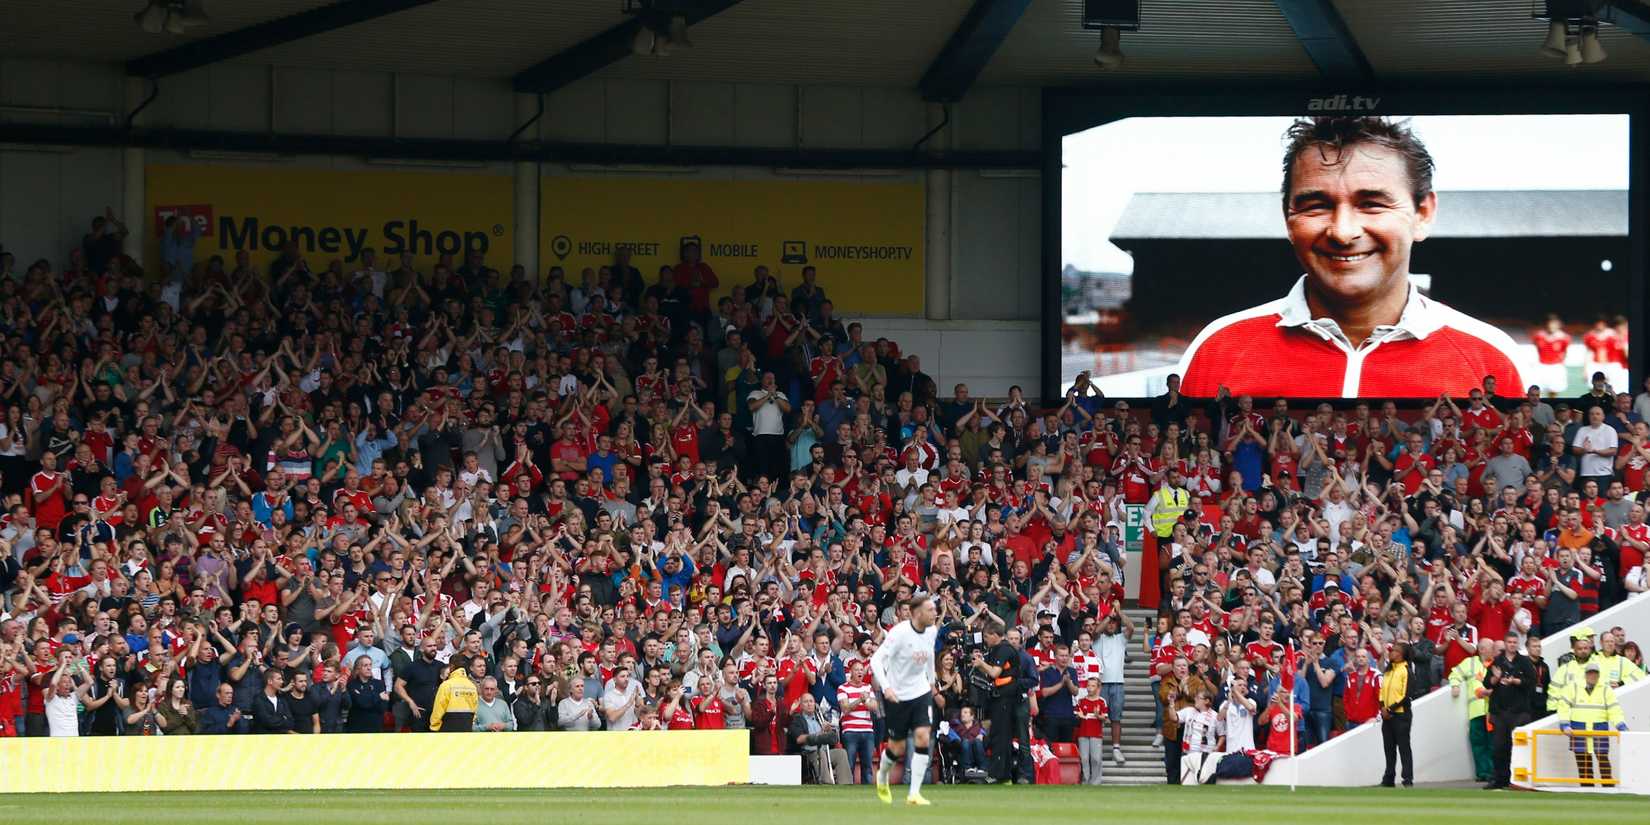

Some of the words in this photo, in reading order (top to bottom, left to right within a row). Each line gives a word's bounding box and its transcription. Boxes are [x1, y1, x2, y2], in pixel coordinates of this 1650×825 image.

[1308, 94, 1381, 111] adi.tv
[219, 216, 368, 263] Money
[579, 243, 609, 256] HIGH
[710, 244, 758, 258] MOBILE
[815, 245, 913, 259] MONEYSHOP.TV
